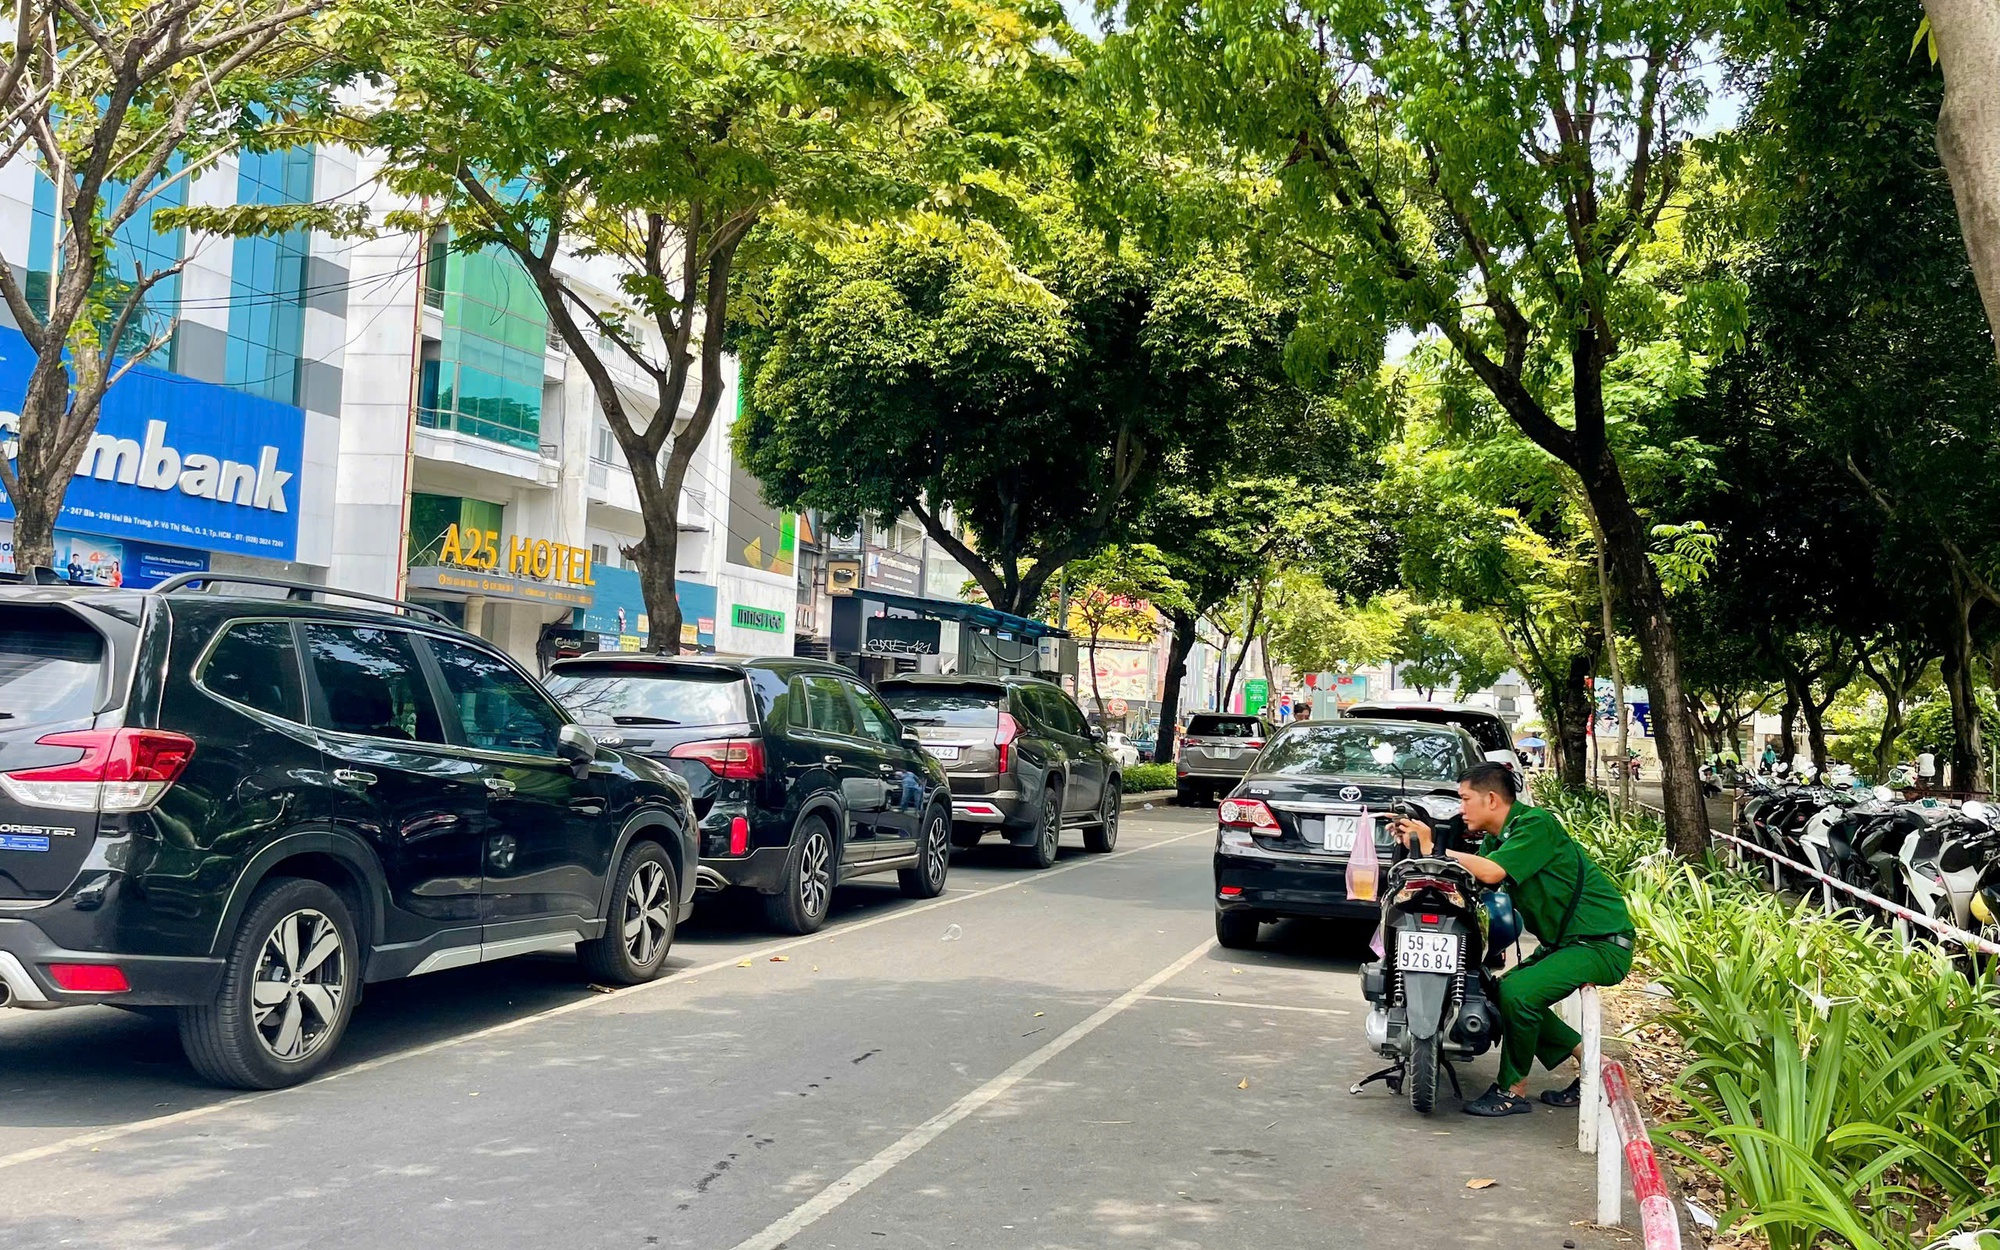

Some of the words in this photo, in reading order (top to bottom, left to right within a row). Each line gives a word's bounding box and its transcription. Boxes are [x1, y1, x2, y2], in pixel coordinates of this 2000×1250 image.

[70, 506, 83, 516] 247
[83, 508, 95, 518] Bis
[98, 511, 111, 520] 249
[111, 513, 123, 522] Hai
[439, 523, 498, 569] A25
[508, 535, 595, 586] HOTEL
[0, 823, 76, 836] ORESTER
[1402, 952, 1452, 970] 926.84
